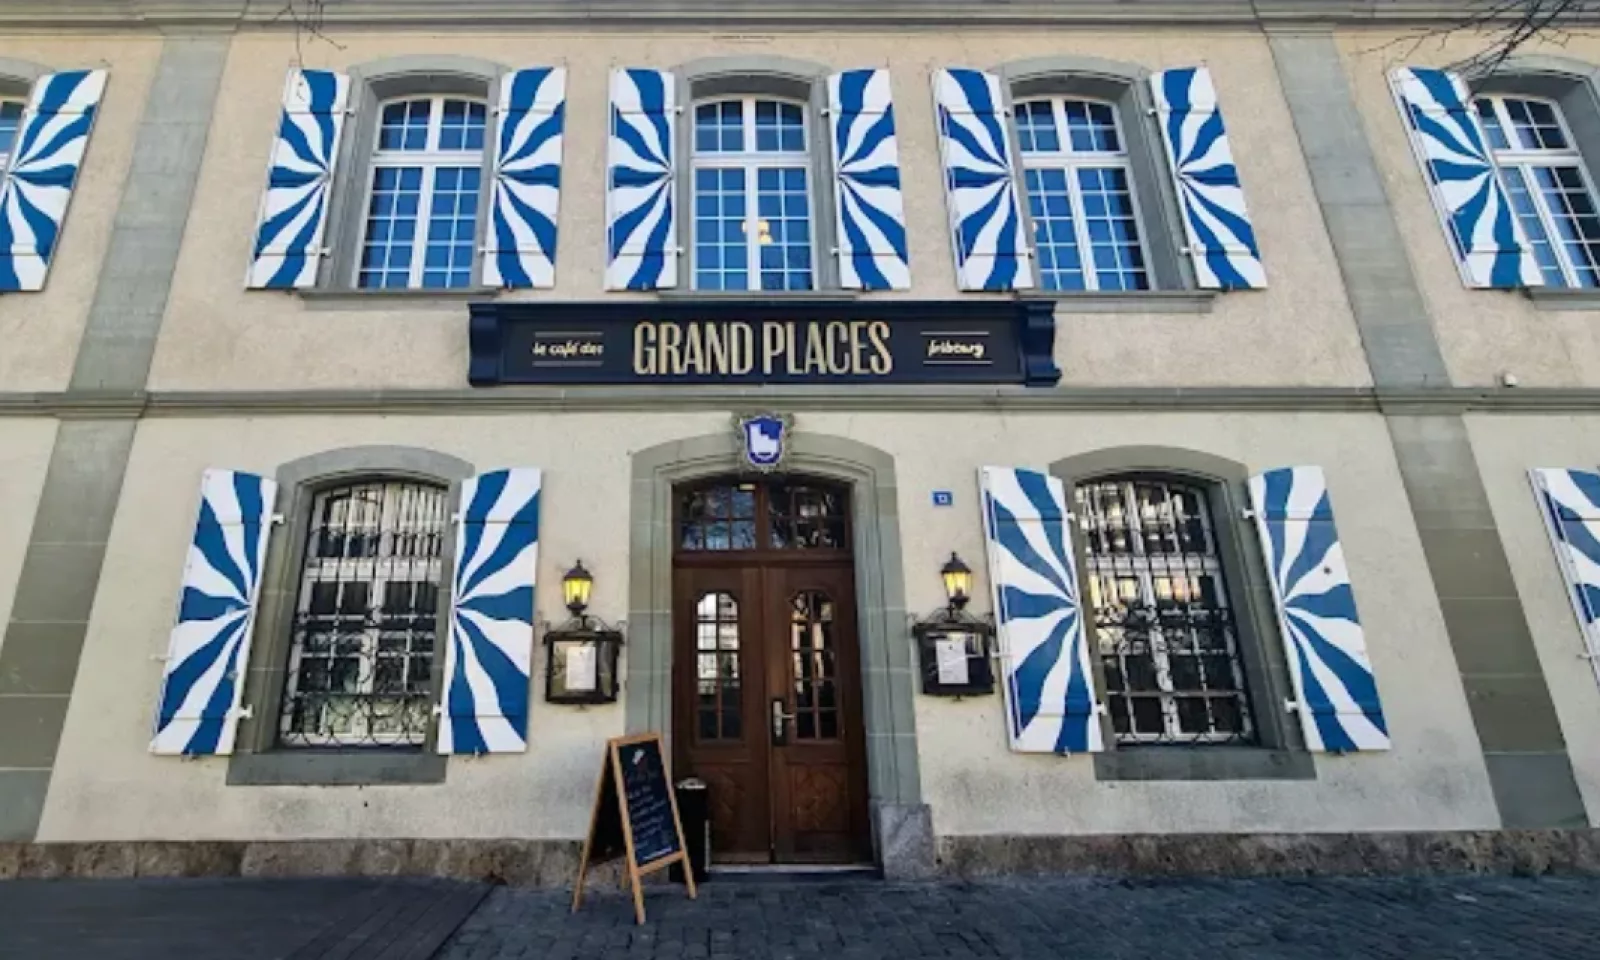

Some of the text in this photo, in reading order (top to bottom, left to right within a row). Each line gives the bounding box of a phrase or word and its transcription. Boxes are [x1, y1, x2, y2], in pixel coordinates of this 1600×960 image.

[633, 321, 893, 375] GRAND PLACES
[928, 339, 984, 359] fribourg
